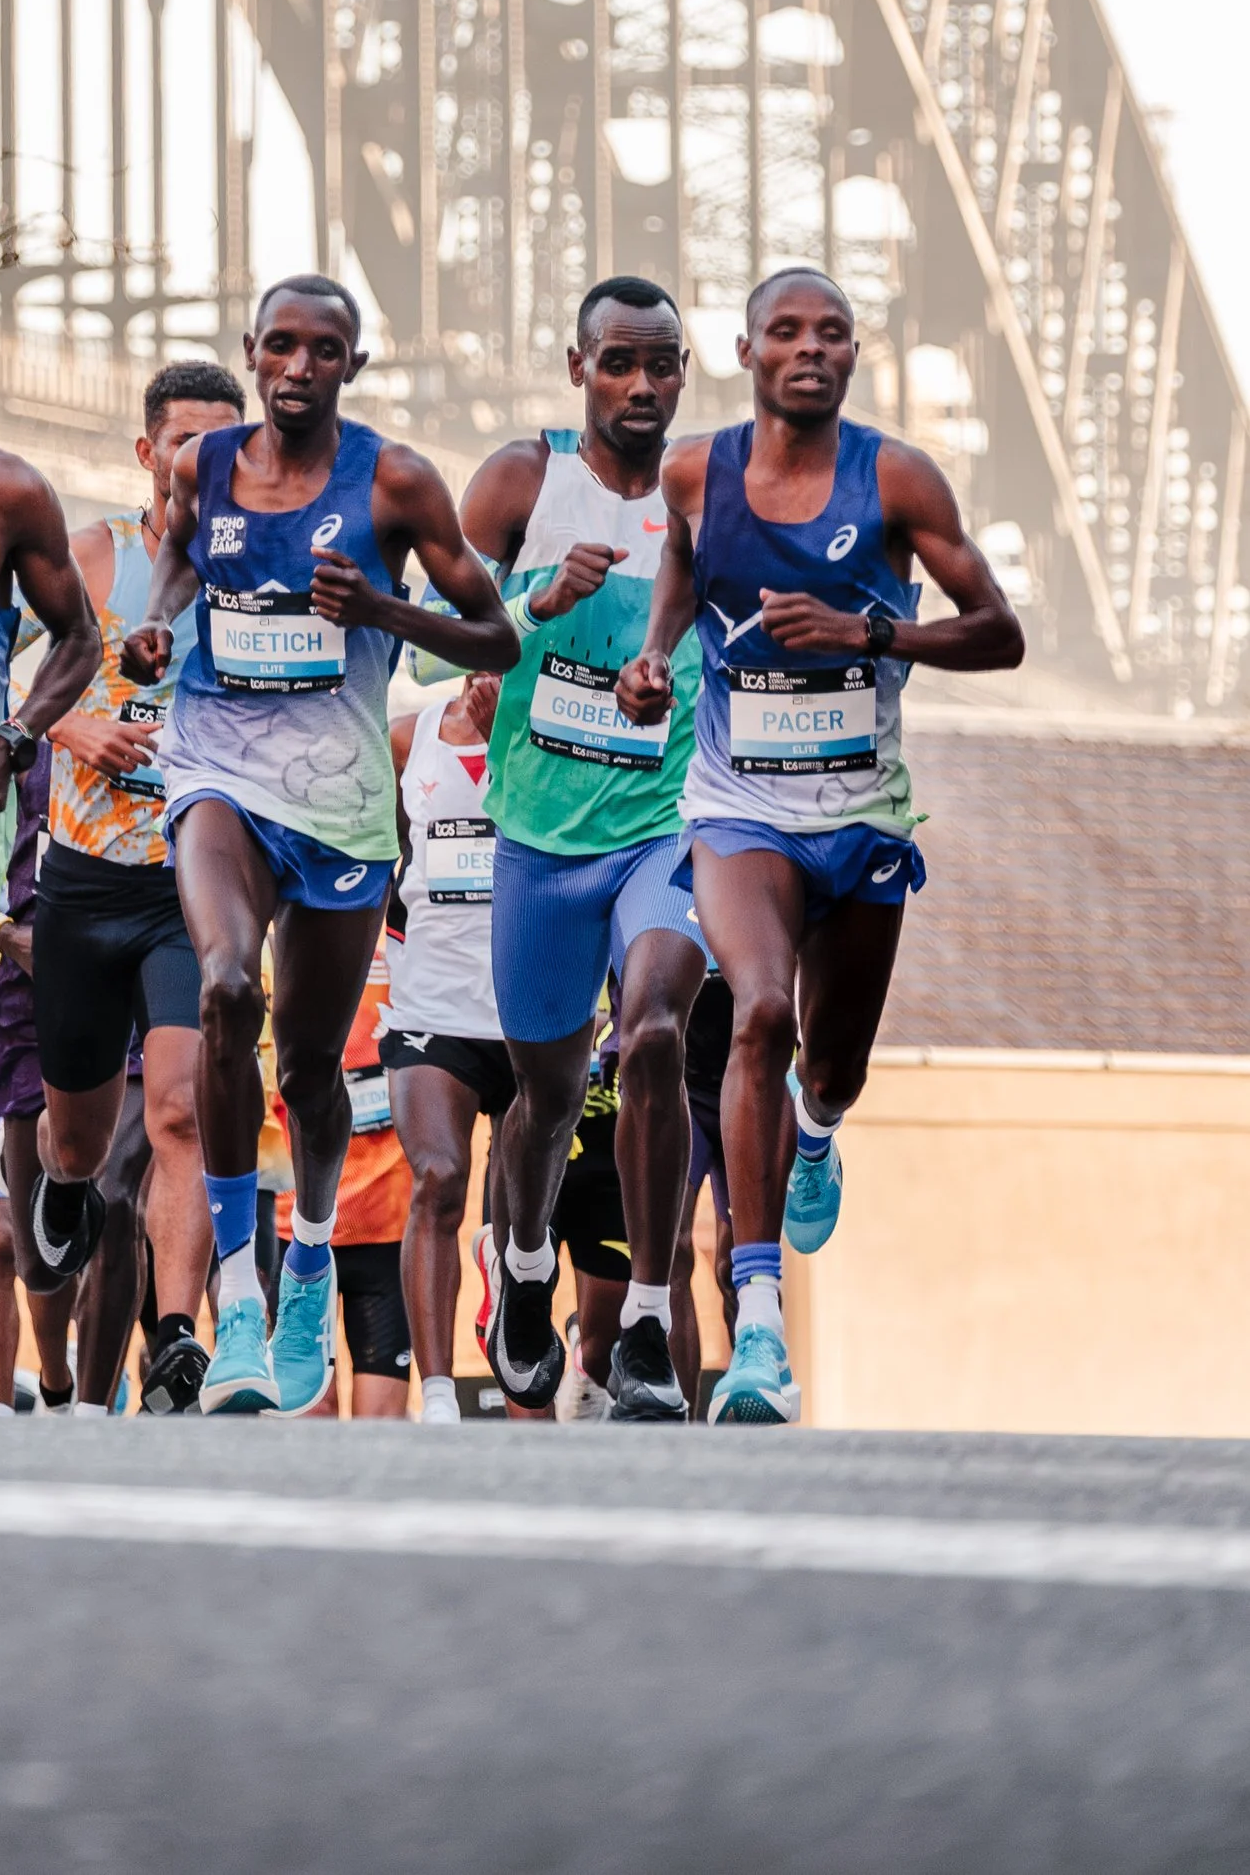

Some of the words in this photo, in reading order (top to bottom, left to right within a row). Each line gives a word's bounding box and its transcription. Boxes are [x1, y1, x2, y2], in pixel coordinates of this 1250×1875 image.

[211, 540, 243, 554] CAMP
[218, 588, 240, 610] tcs
[226, 629, 323, 652] NGETICH
[260, 664, 286, 675] ELITE
[550, 657, 573, 679] tcs
[741, 670, 766, 690] tcs
[843, 680, 866, 690] TATA
[130, 703, 155, 723] tcs
[552, 696, 646, 730] GOBEN
[762, 709, 845, 733] PACER
[583, 734, 609, 747] ELITE
[792, 744, 820, 755] ELITE
[435, 821, 455, 837] tcs
[457, 852, 494, 870] DES
